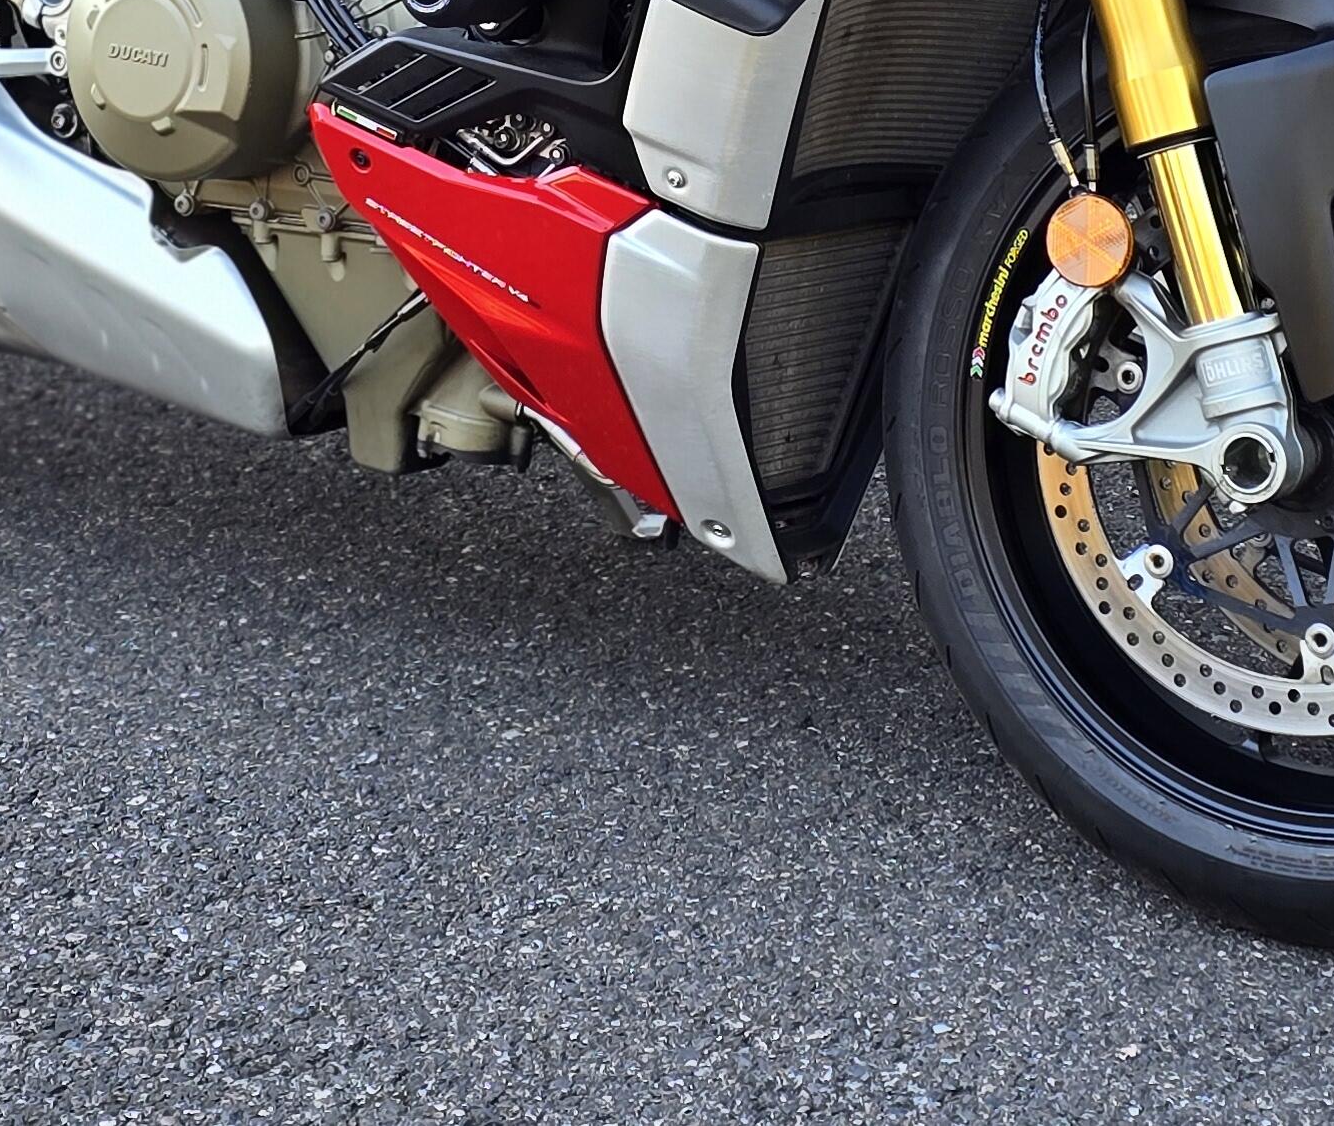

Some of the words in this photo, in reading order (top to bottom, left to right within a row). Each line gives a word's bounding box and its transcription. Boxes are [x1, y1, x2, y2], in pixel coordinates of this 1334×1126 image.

[107, 42, 169, 68] DUCATI
[929, 267, 972, 409] ROSSO
[977, 265, 1010, 348] marchesini
[1017, 294, 1068, 386] brembo
[927, 425, 978, 599] DIABLO
